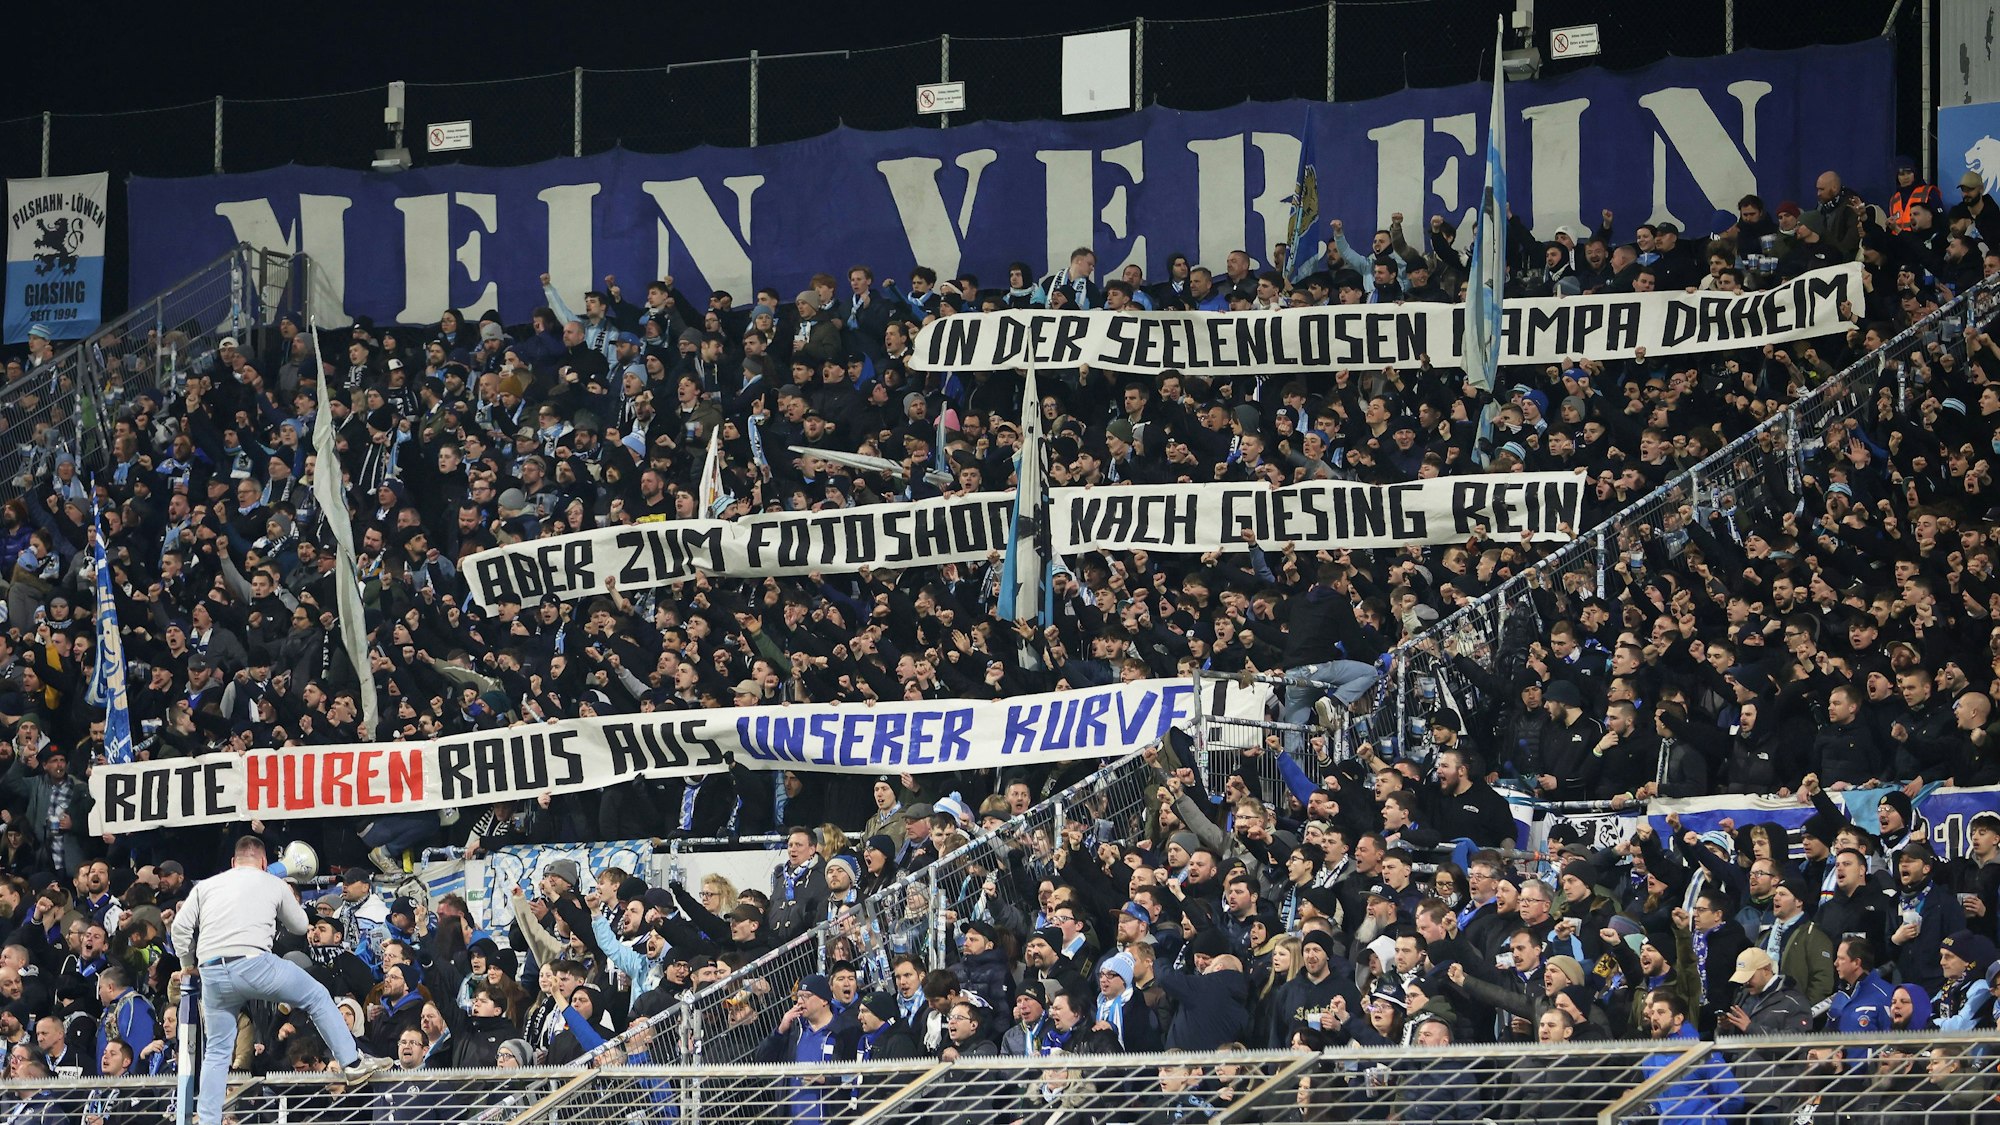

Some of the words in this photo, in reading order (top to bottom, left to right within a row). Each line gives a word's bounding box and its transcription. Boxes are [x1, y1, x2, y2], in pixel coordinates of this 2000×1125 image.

[12, 193, 63, 230] PILSHAHN
[215, 174, 765, 331] MEIN
[877, 80, 1772, 294] VEREIN
[24, 281, 86, 307] GIASING
[54, 308, 77, 321] 1994
[928, 318, 982, 366] IN
[991, 315, 1090, 365] DER
[1098, 312, 1428, 369] SEELENLOSEN
[1662, 273, 1849, 348] DAHEIM
[477, 538, 596, 600] ABER
[616, 526, 723, 584] ZUM
[747, 498, 1054, 568] FOTOSHOO
[1069, 493, 1197, 547] NACH
[1220, 484, 1427, 543] GIESING
[1451, 481, 1580, 537] REIN
[104, 761, 237, 823] ROTE
[246, 748, 424, 811] HUREN
[438, 729, 584, 800] RAUS
[603, 718, 725, 776] AUS
[736, 707, 974, 766] UNSERER
